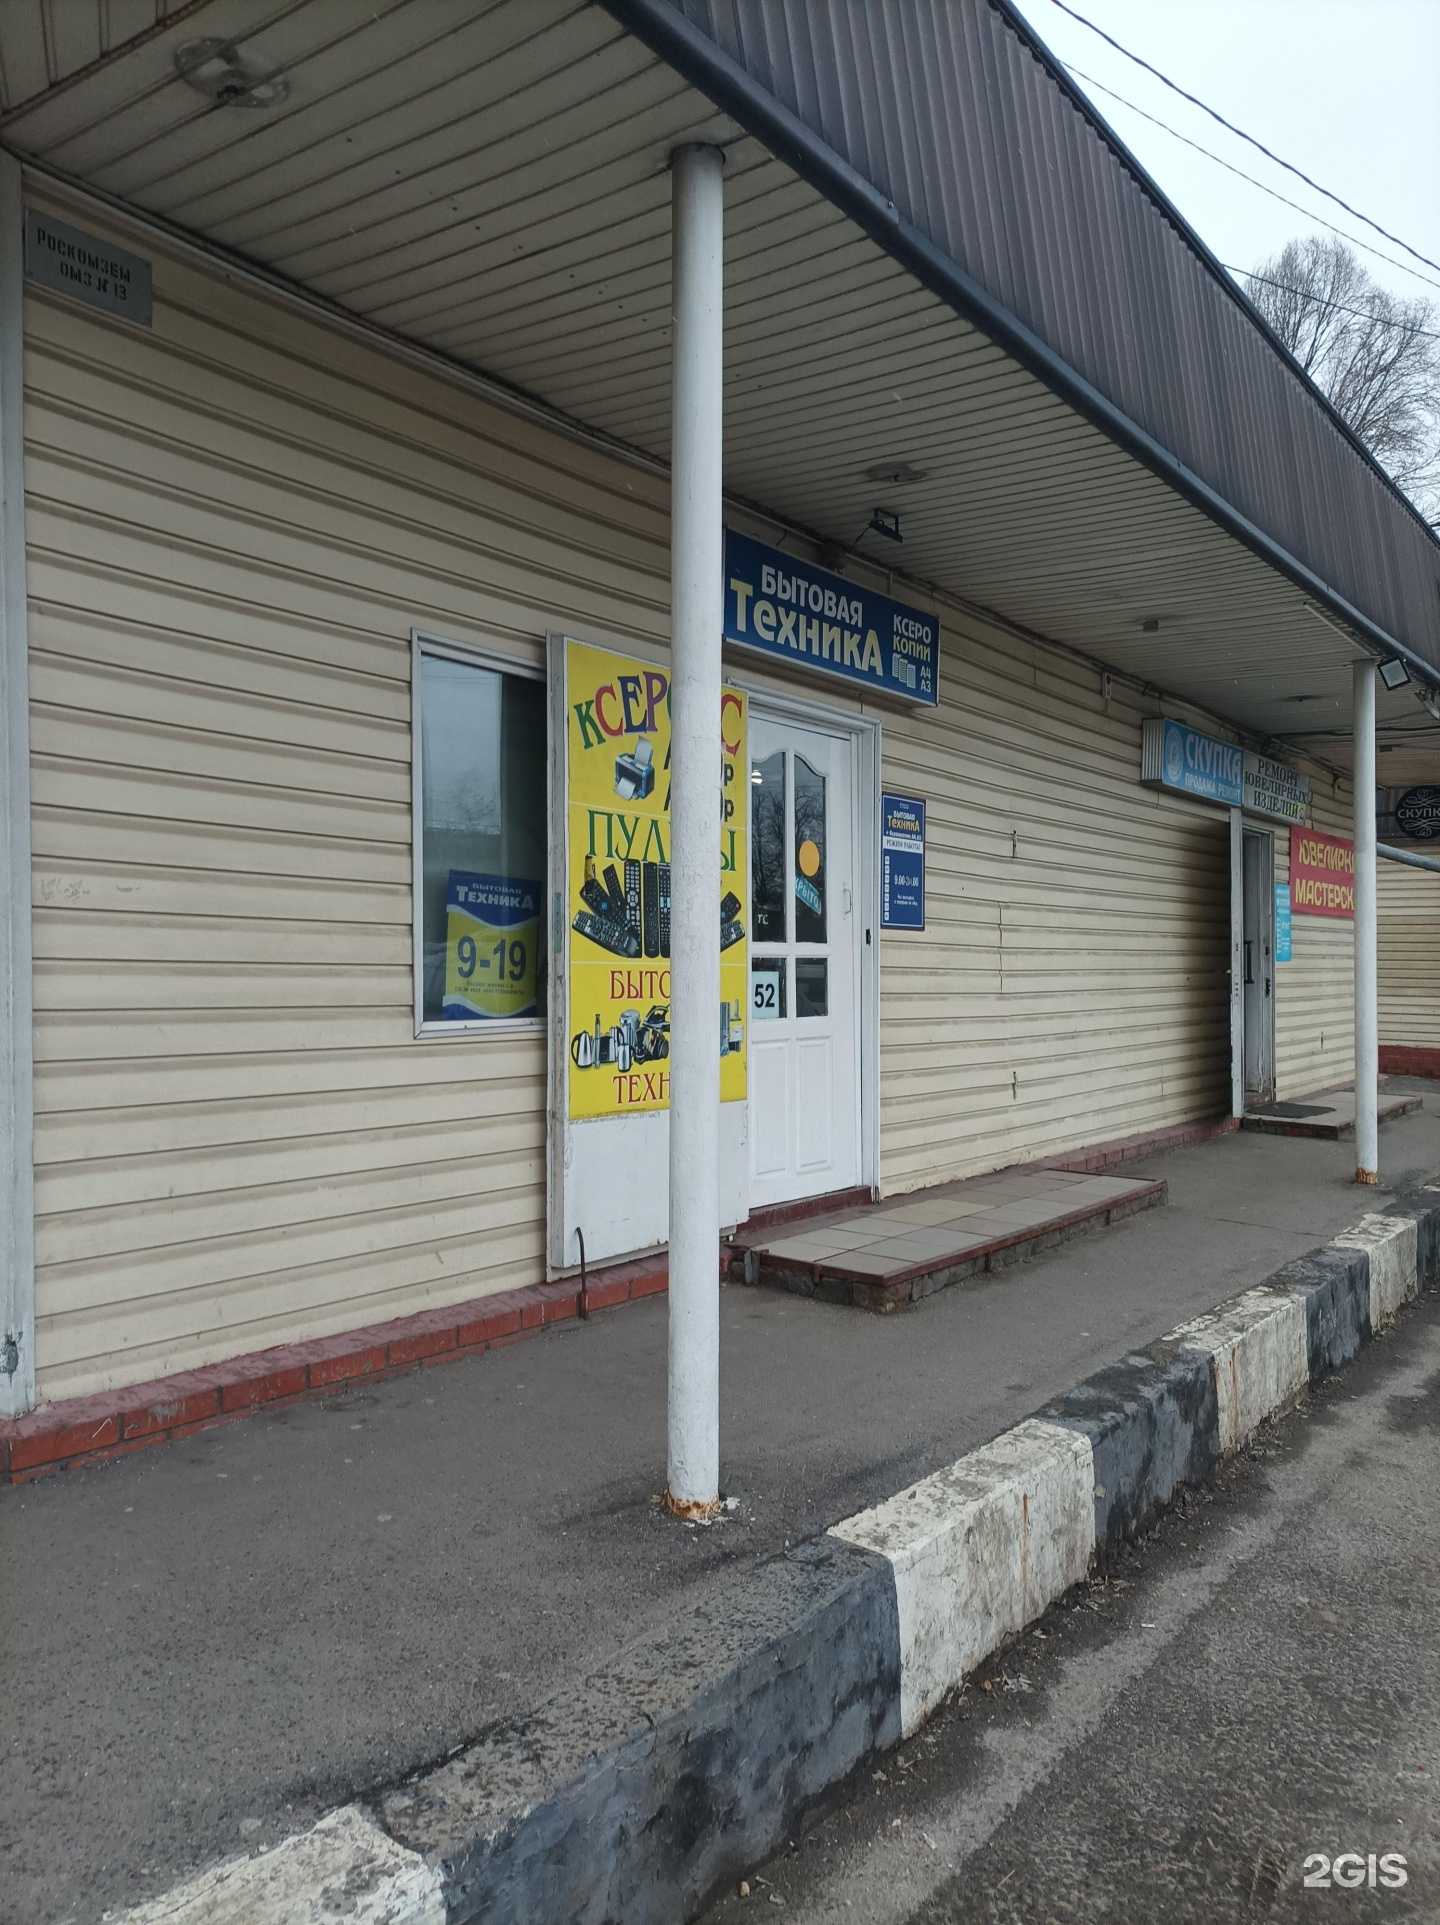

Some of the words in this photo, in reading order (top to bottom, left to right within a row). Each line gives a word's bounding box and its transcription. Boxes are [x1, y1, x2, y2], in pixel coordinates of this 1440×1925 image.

[37, 228, 131, 283] РОСКОМЗЕМ
[762, 564, 863, 628] БЫТОВАЯ
[893, 613, 932, 644] КСЕРО
[893, 633, 931, 662] КОПИИ
[920, 666, 931, 679] А4
[920, 679, 932, 693] А3
[573, 671, 743, 757] КСЕРС
[1185, 734, 1240, 784] СКУПКА
[1398, 808, 1440, 818] СКУПК
[588, 810, 737, 871] ПУЛЫ
[1299, 840, 1354, 873] ЮВЕЛИРН
[1295, 878, 1354, 910] МАСТЕРСК
[457, 935, 527, 981] 9-19
[610, 970, 671, 999] БЫТО
[754, 983, 775, 1008] 52
[613, 1071, 671, 1104] ТЕХН
